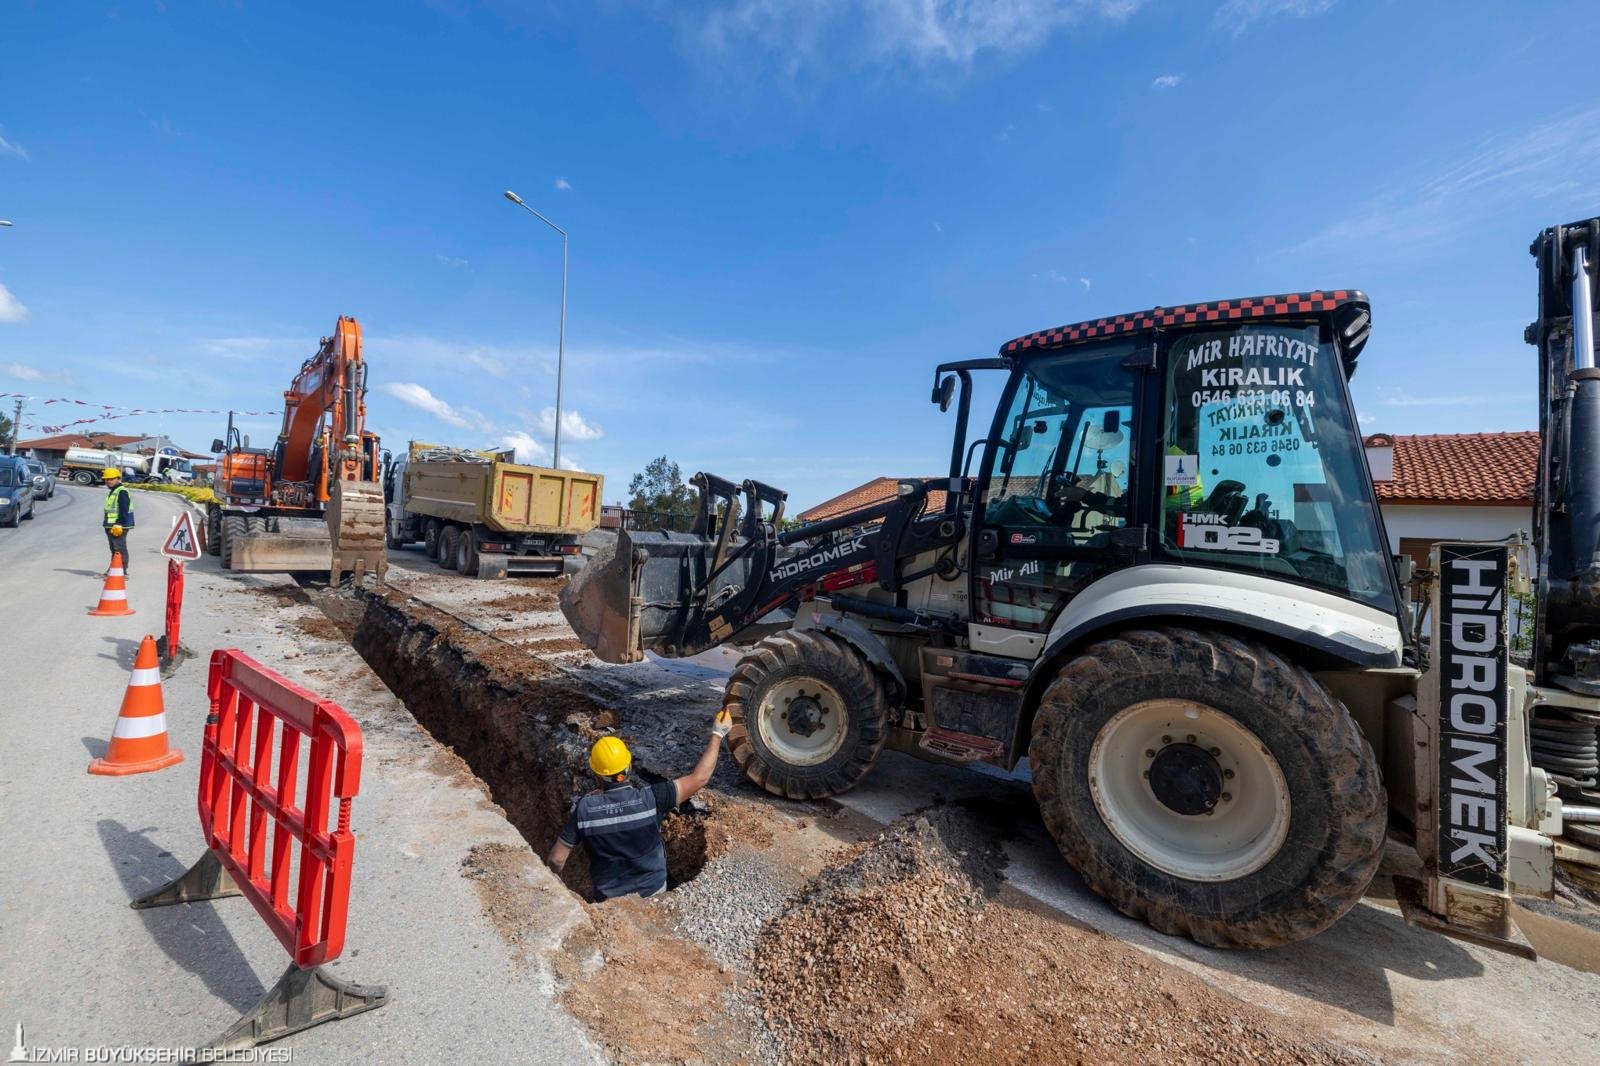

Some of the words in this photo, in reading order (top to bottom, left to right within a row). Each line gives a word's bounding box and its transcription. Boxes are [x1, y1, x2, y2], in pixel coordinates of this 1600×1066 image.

[1201, 367, 1305, 387] KiRALIK
[1191, 389, 1231, 408] 0546
[1236, 389, 1265, 407] 633
[1271, 389, 1291, 407] 06
[1295, 390, 1315, 408] 84
[1183, 512, 1229, 525] HMK
[990, 567, 1014, 586] Mir
[1019, 560, 1039, 577] Ali
